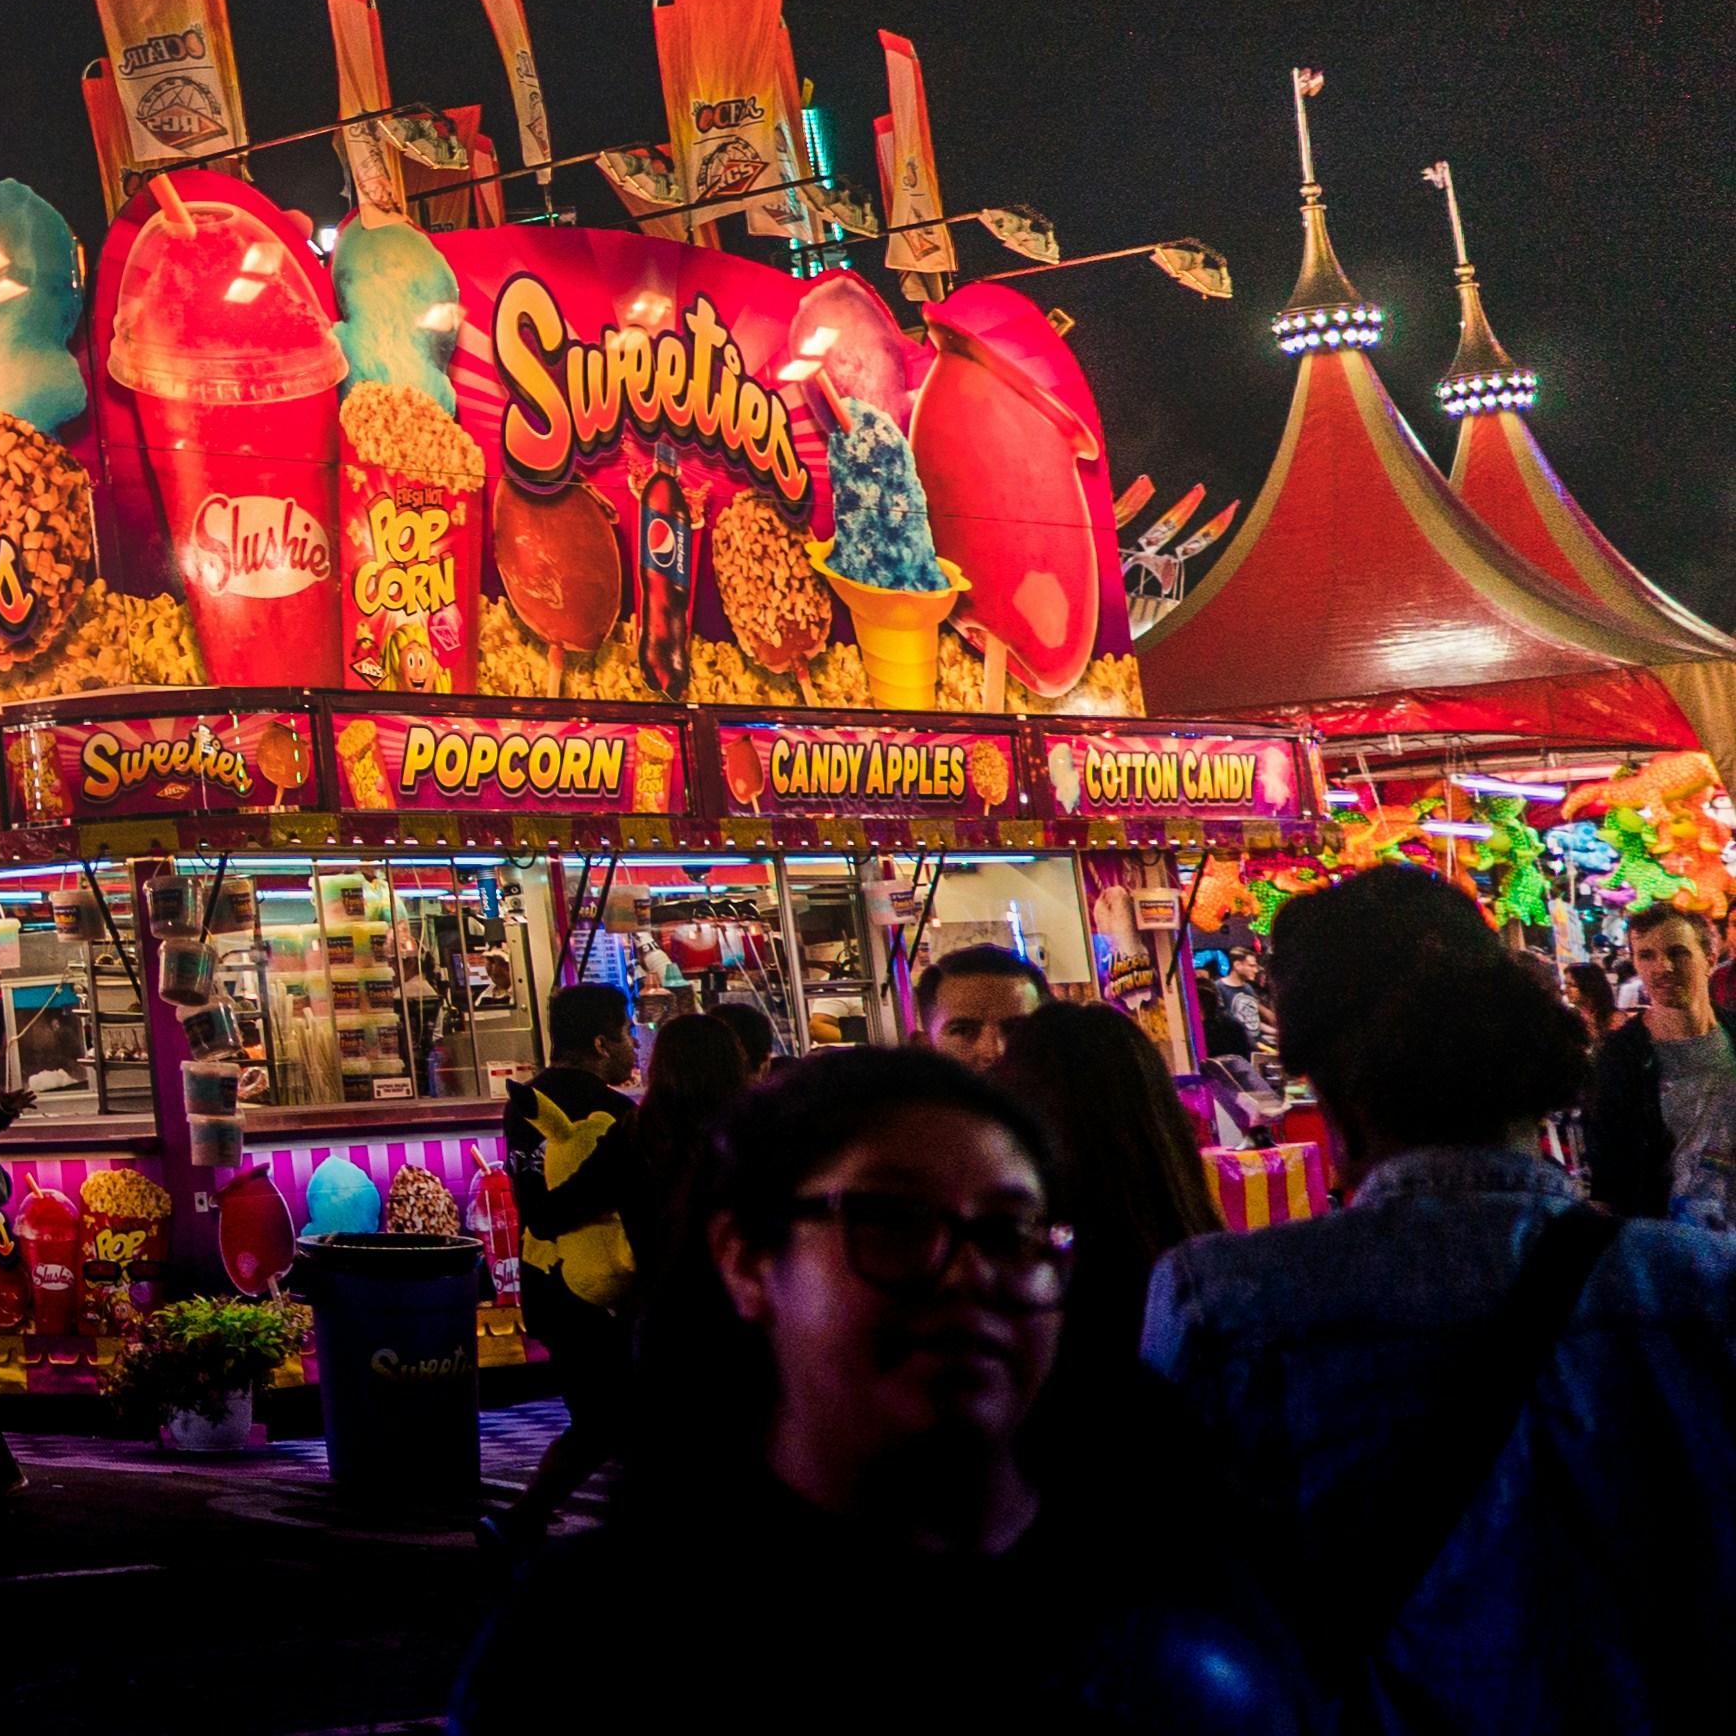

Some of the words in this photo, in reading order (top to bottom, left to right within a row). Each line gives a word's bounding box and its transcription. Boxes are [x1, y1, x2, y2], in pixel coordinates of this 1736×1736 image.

[493, 272, 810, 505] Sweeties
[192, 496, 328, 593] Slushie
[367, 493, 450, 570] POP
[354, 553, 456, 616] CORN
[82, 724, 253, 798] Sweeties
[400, 725, 625, 795] POPCORN
[771, 738, 866, 794] CANDY
[864, 741, 966, 797] APPLES
[1085, 749, 1178, 803] COTTON
[1181, 750, 1255, 804] CANDY
